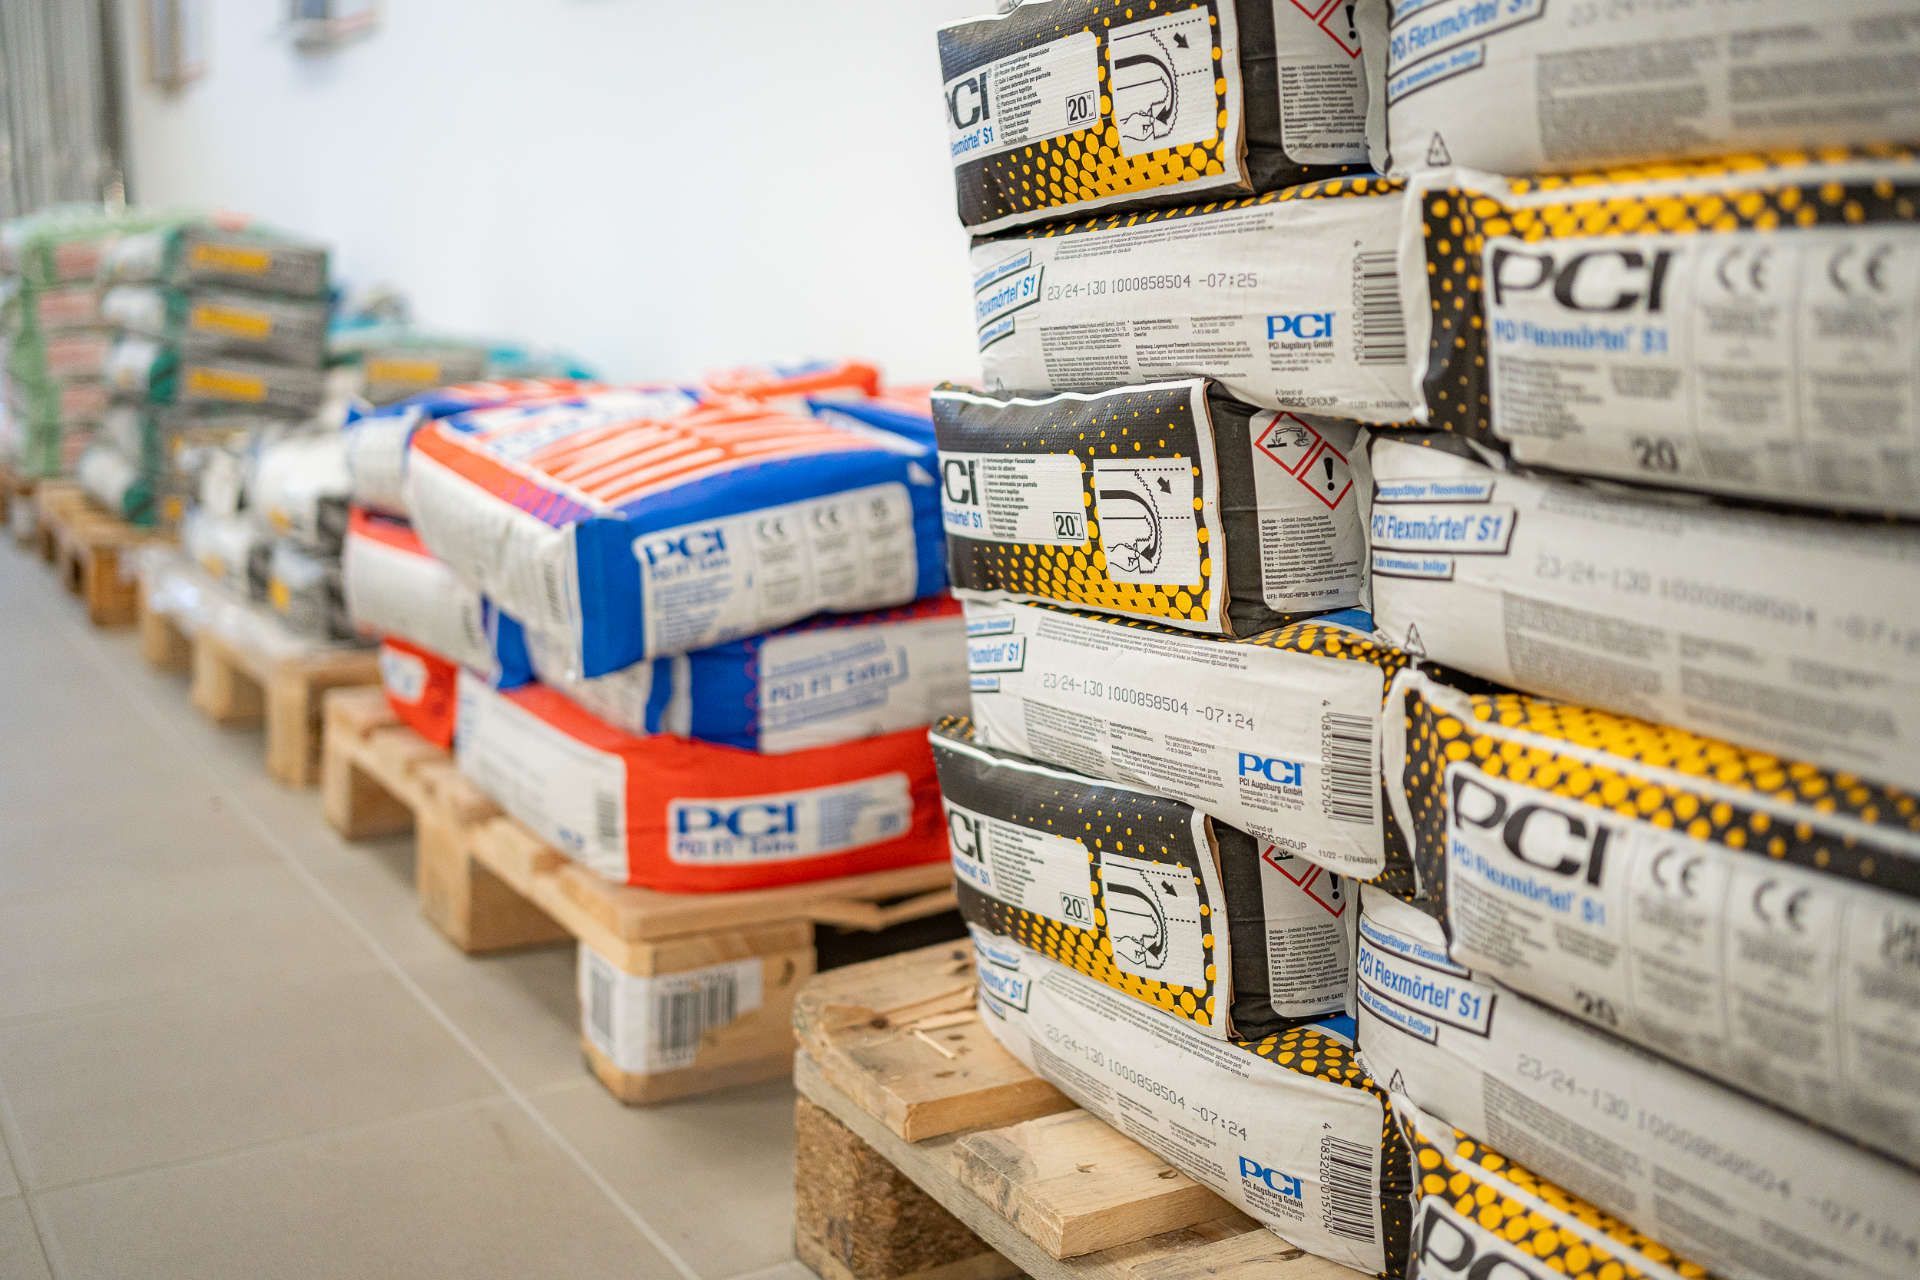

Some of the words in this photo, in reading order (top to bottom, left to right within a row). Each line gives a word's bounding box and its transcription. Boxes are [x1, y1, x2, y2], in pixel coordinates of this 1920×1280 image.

[1068, 96, 1088, 122] 20
[983, 126, 995, 145] S1
[1023, 274, 1037, 297] S1
[1047, 280, 1107, 301] 23/24-130
[1111, 274, 1191, 294] 1000858504
[1198, 272, 1258, 289] -07:25
[1493, 246, 1674, 312] PCI
[1266, 312, 1333, 340] PCI
[1281, 341, 1311, 351] Augsburg
[1055, 514, 1076, 537] 20
[1477, 514, 1503, 542] S1
[645, 527, 726, 566] PCI
[1042, 672, 1104, 698] 23/24-130
[1107, 685, 1189, 716] 1000858504
[1195, 705, 1255, 732] -07:24
[1238, 751, 1302, 787] PCI
[1239, 777, 1250, 787] PCI
[1251, 780, 1282, 794] Augsburg
[677, 801, 798, 839] PCI
[1453, 774, 1610, 887] PCI
[1275, 836, 1308, 851] GROUP
[1062, 896, 1082, 920] 20
[1359, 947, 1374, 977] PCI
[1375, 959, 1450, 1010] Flexmörtel
[1458, 991, 1481, 1020] S1
[1108, 1058, 1186, 1110] 1000858504
[1191, 1104, 1248, 1142] -07:24
[1321, 1122, 1333, 1130] 4
[1319, 1137, 1332, 1183] 083200
[1238, 1155, 1303, 1200] PCI
[1253, 1183, 1283, 1203] Augsburg
[1283, 1195, 1304, 1209] GmbH
[1319, 1186, 1333, 1230] 015704
